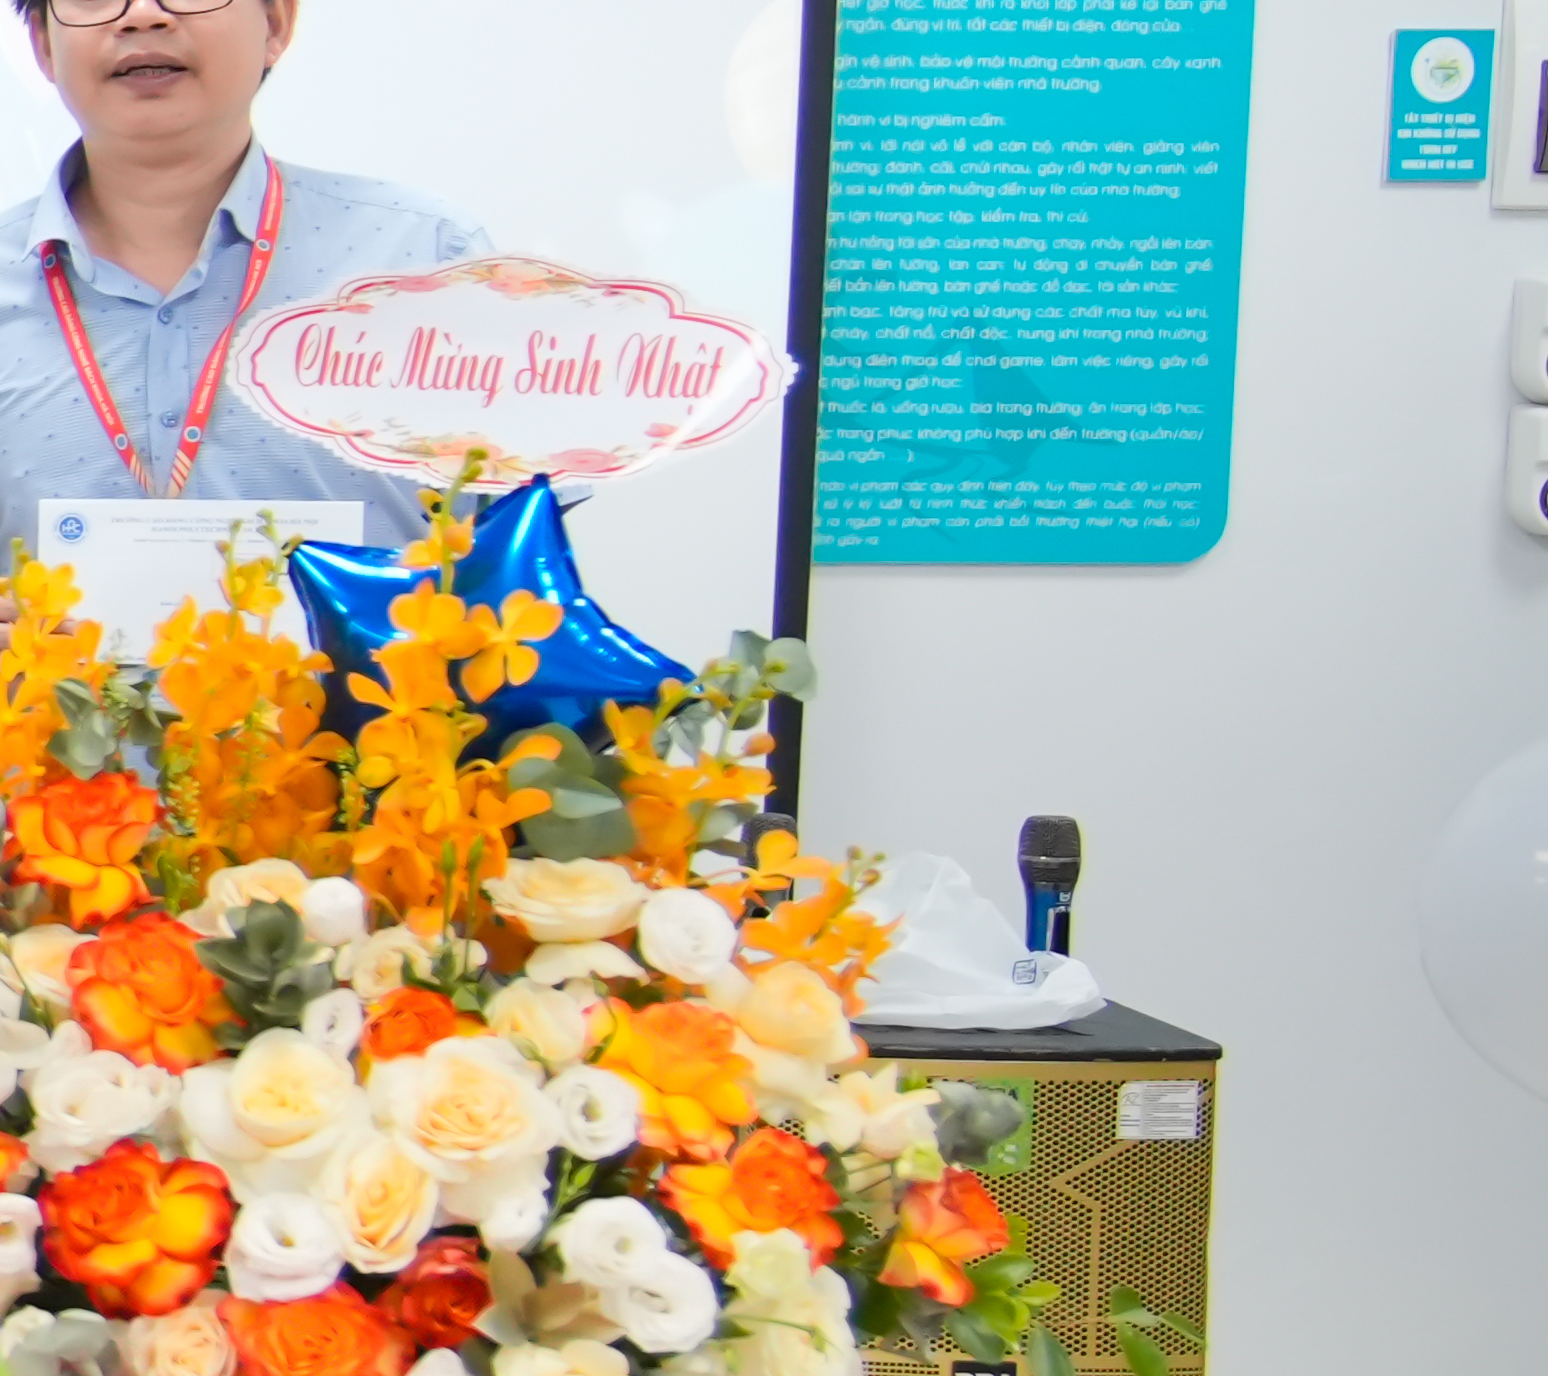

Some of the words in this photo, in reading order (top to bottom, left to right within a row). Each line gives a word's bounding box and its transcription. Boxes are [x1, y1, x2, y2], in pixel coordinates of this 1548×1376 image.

[295, 323, 384, 388] Chúc
[391, 326, 504, 408] Mừng
[514, 330, 602, 396] Sinh
[618, 333, 724, 415] Nhật
